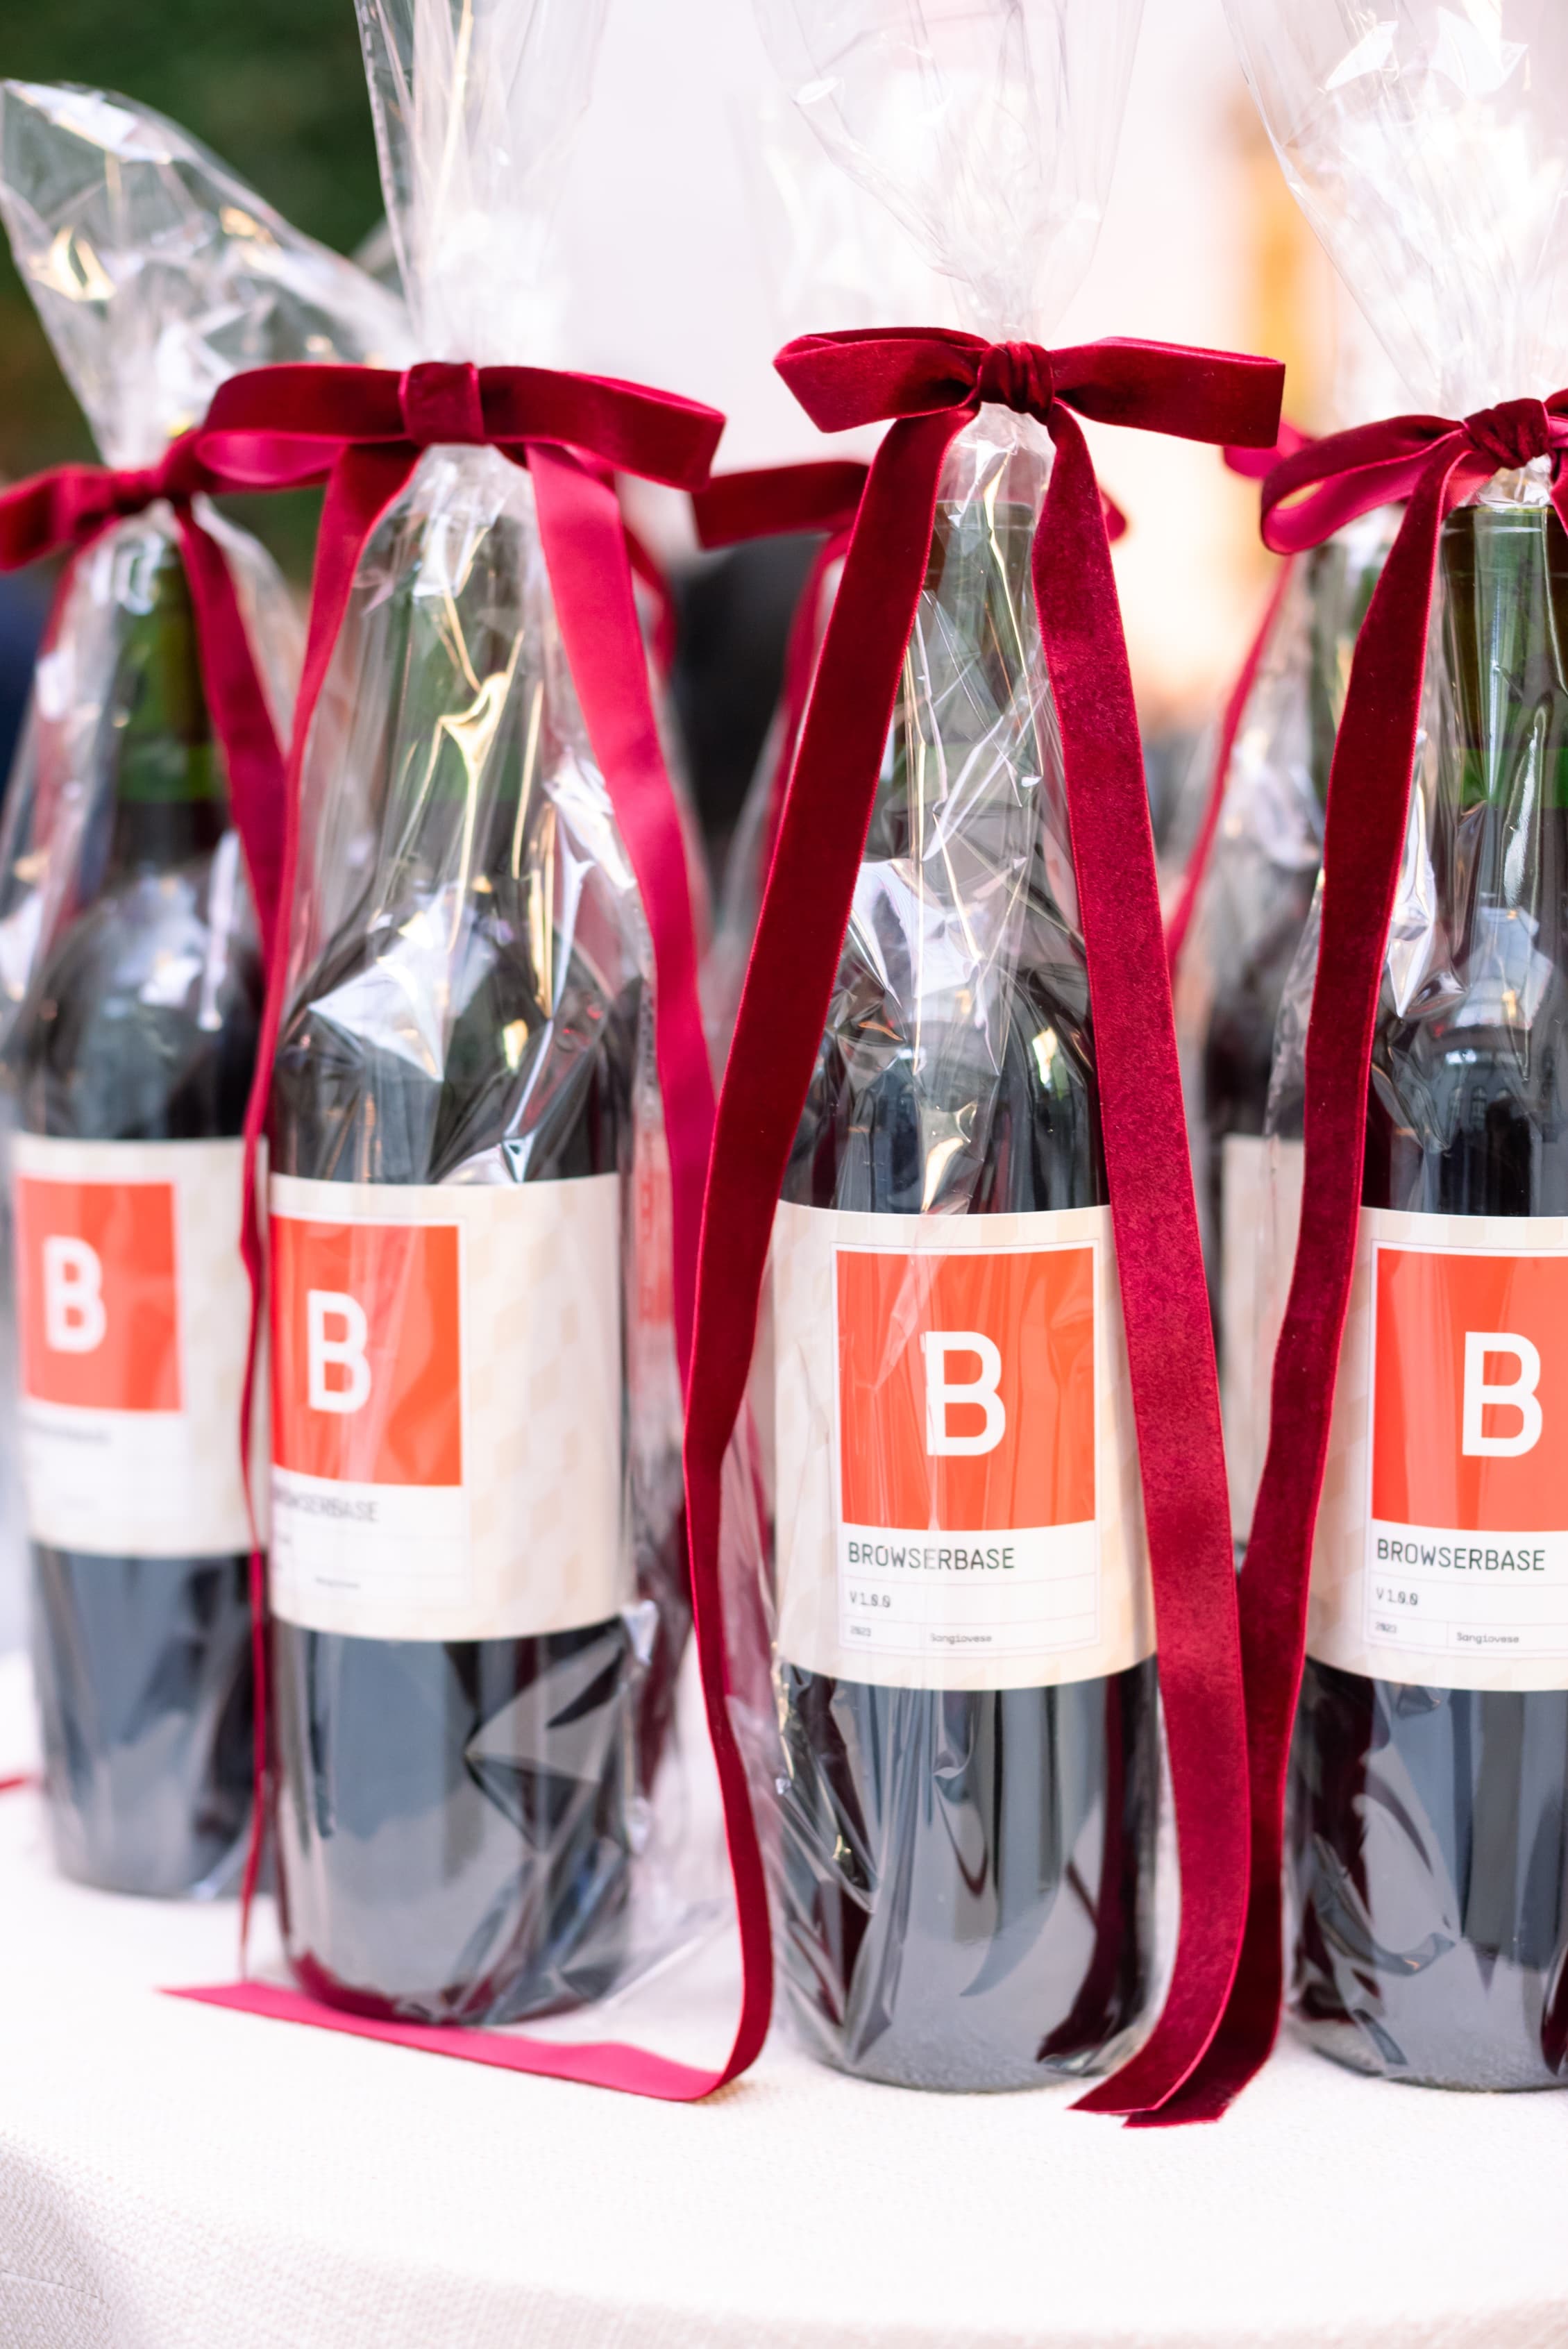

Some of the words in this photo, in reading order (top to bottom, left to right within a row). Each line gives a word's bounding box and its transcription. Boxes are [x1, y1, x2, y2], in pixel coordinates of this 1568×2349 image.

[43, 1236, 106, 1353] B
[306, 1290, 371, 1413] B
[924, 1331, 1006, 1456] B
[1462, 1331, 1543, 1458] B
[848, 1541, 1015, 1570] BROWSERBASE
[1377, 1538, 1546, 1572] BROWSERBASE
[929, 1633, 993, 1645] Sangiovese
[1456, 1632, 1520, 1645] Sangiovese
